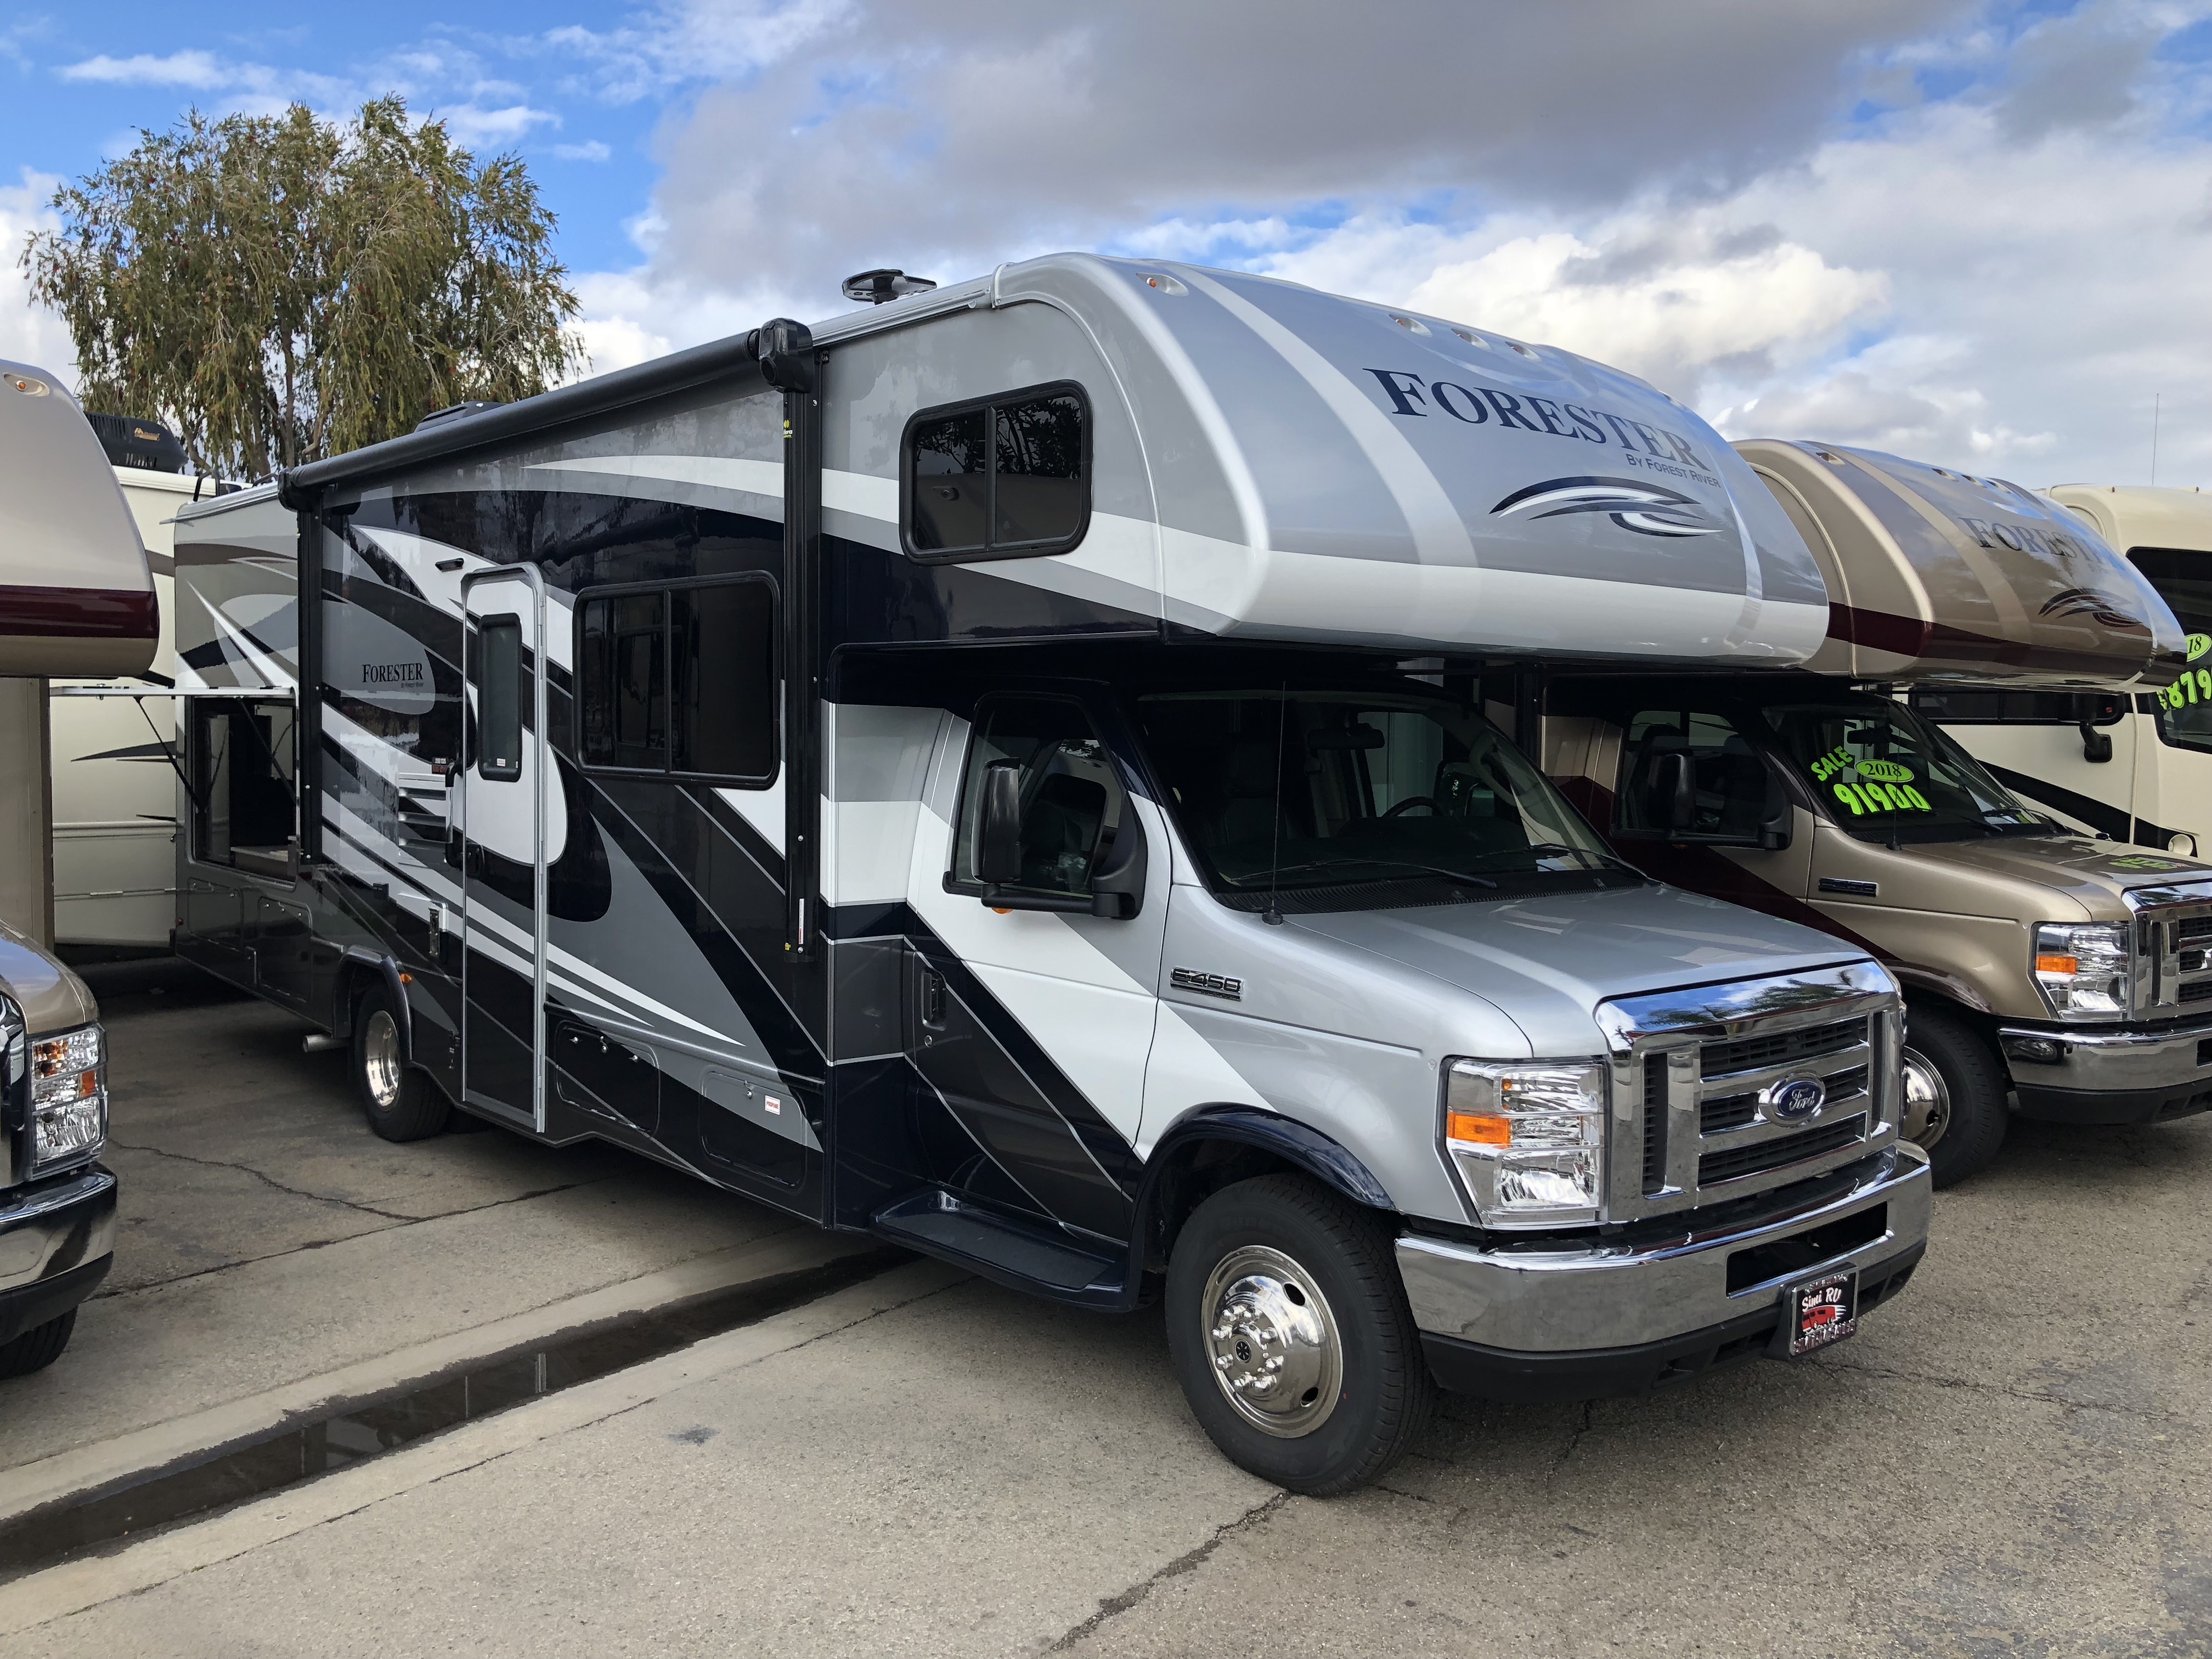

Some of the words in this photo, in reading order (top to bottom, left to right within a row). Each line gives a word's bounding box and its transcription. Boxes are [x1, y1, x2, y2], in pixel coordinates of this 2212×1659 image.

[1362, 368, 1711, 471] FORESTER
[1626, 454, 1643, 467] BY
[1645, 458, 1688, 478] FOREST
[1689, 470, 1721, 488] RIVER
[1957, 517, 2104, 563] FOREST
[2188, 636, 2202, 654] 18
[362, 663, 423, 682] FORESTER
[2166, 669, 2212, 708] 879
[1811, 746, 1853, 781] SALE
[1865, 763, 1902, 777] 2018
[1833, 783, 1932, 815] 91900
[1789, 1088, 1815, 1111] Ford
[1802, 1290, 1822, 1312] Simi
[1826, 1287, 1842, 1303] RV
